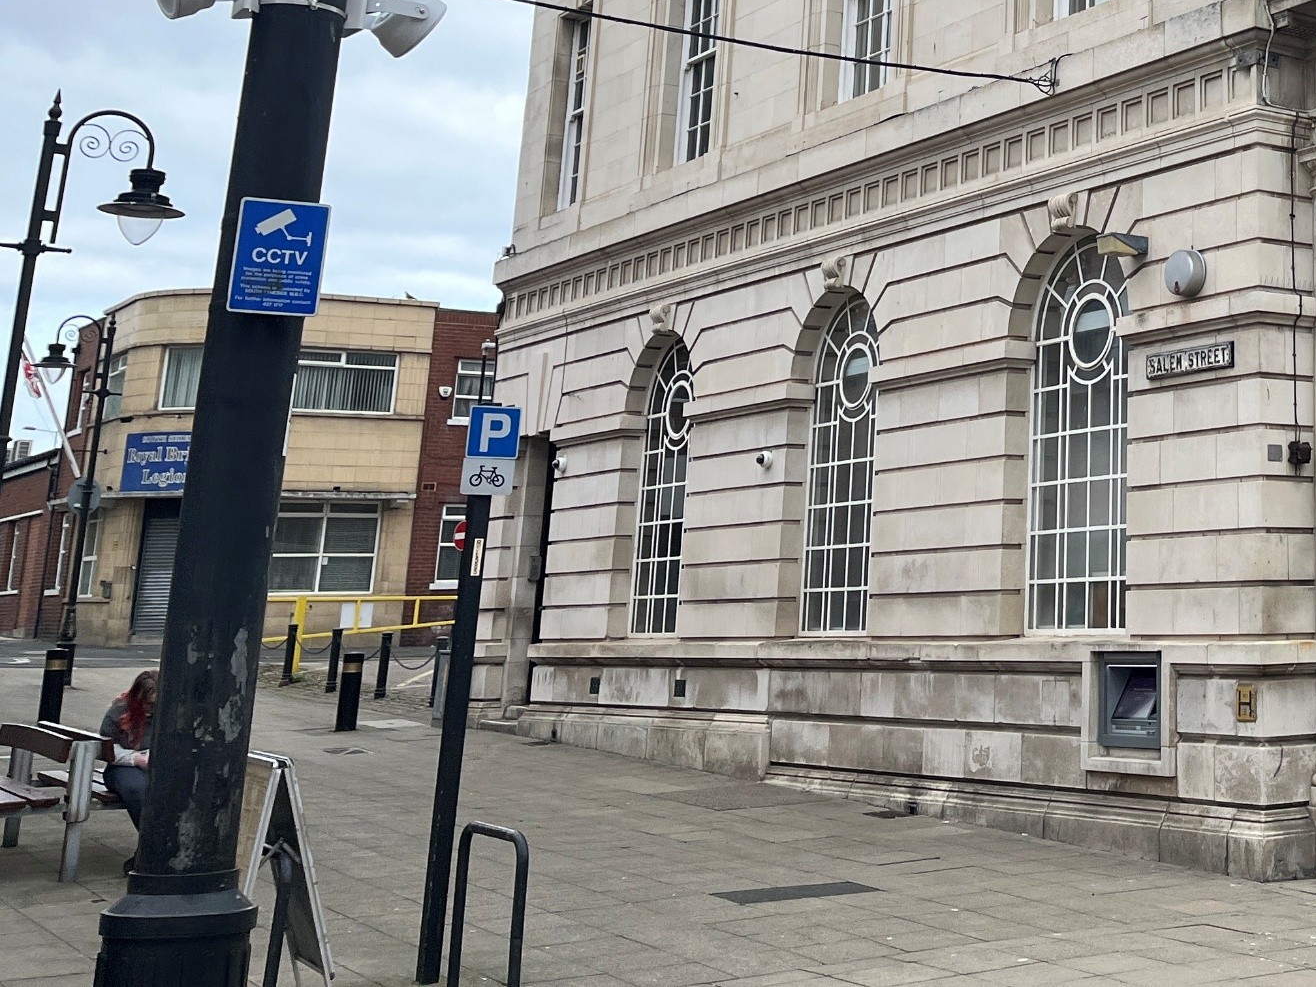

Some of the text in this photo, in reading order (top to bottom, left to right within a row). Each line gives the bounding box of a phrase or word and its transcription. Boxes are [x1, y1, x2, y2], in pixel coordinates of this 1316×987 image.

[251, 247, 308, 265] CCTV
[1148, 347, 1227, 374] SALEM STREET
[479, 413, 511, 453] P
[127, 446, 190, 465] Royal Bri
